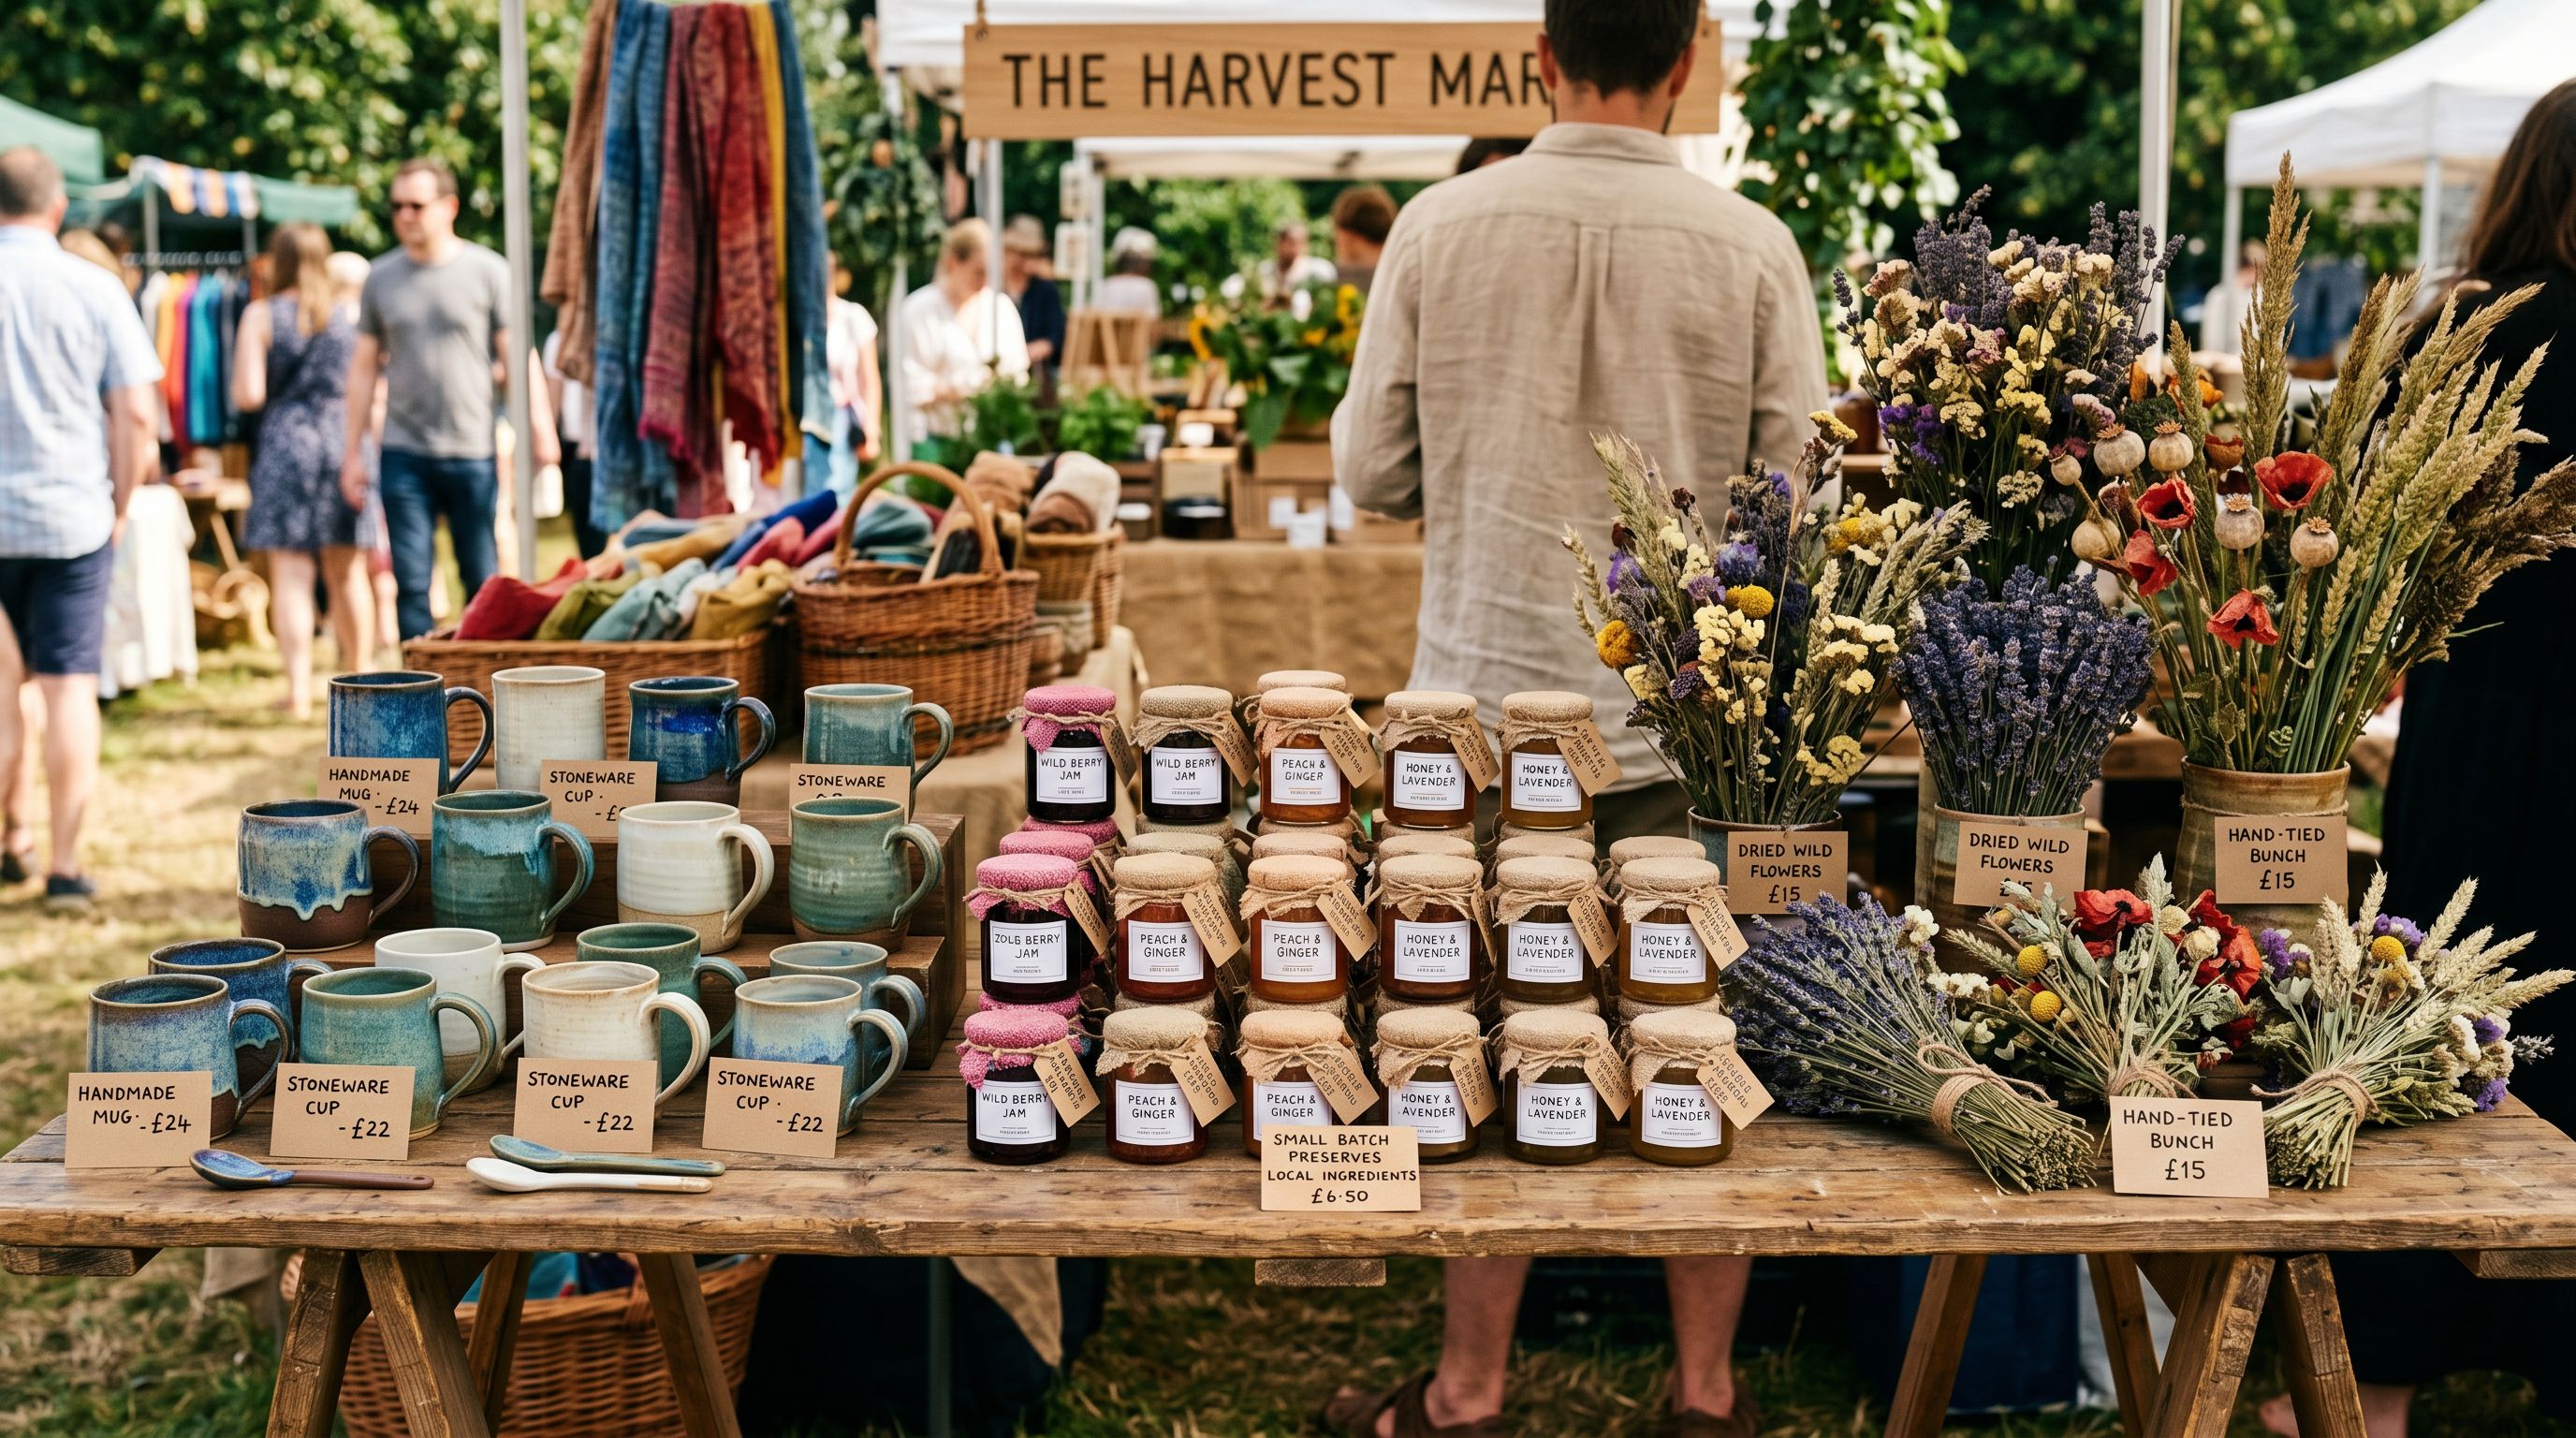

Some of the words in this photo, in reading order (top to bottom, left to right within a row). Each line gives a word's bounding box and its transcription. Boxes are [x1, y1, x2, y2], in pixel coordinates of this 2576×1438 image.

[1003, 52, 1107, 110] THE
[1144, 51, 1396, 108] HARVEST
[1041, 757, 1067, 769] WILD
[1071, 757, 1103, 768] BERRY
[1155, 758, 1181, 769] WILD
[1186, 758, 1217, 769] BERRY
[1282, 759, 1315, 769] PEACH
[1406, 763, 1442, 773] HONEY
[1446, 764, 1452, 773] &
[1523, 764, 1558, 774] HONEY
[1562, 766, 1569, 774] &
[329, 770, 410, 782] HANDMADE
[550, 771, 636, 785] STONEWARE
[798, 774, 886, 787] STONEWARE
[1060, 771, 1081, 780] JAM
[1175, 771, 1195, 780] JAM
[1285, 771, 1323, 781] GINGER
[1402, 775, 1456, 786] LAVENDER
[1518, 776, 1573, 787] LAVENDER
[1969, 833, 2019, 849] DRIED
[2027, 838, 2070, 854] WILD
[1738, 844, 1785, 858] DRIED
[1793, 844, 1832, 858] WILD
[2250, 848, 2305, 863] BUNCH
[1981, 855, 2053, 873] FLOWERS
[1750, 864, 1822, 878] FLOWERS
[2260, 870, 2295, 889] £15
[1768, 885, 1801, 904] £15
[1026, 934, 1060, 945] BERRY
[1140, 934, 1177, 944] PEACH
[1181, 934, 1188, 944] &
[1273, 933, 1310, 944] PEACH
[1315, 934, 1321, 944] &
[1407, 934, 1445, 945] HONEY
[1449, 934, 1456, 944] &
[1519, 934, 1558, 945] HONEY
[1563, 936, 1569, 945] &
[1642, 935, 1680, 946] HONEY
[1685, 936, 1691, 946] &
[1015, 948, 1039, 958] JAM
[1144, 947, 1186, 958] GINGER
[1277, 947, 1319, 958] GINGER
[1403, 947, 1460, 958] LAVENDER
[1517, 947, 1574, 959] LAVENDER
[1639, 947, 1696, 959] LAVENDER
[287, 1077, 389, 1093] STONEWARE
[528, 1072, 629, 1088] STONEWARE
[718, 1071, 815, 1091] STONEWARE
[79, 1086, 175, 1101] HANDMADE
[982, 1093, 1008, 1104] WILD
[1013, 1093, 1048, 1104] BERRY
[1267, 1093, 1304, 1104] PEACH
[1310, 1095, 1315, 1104] &
[1401, 1093, 1440, 1104] HONEY
[551, 1095, 584, 1108] CUP
[1129, 1095, 1164, 1106] PEACH
[1170, 1096, 1177, 1105] &
[1531, 1095, 1570, 1107] HONEY
[1575, 1097, 1582, 1106] &
[1655, 1095, 1693, 1107] HONEY
[1699, 1097, 1705, 1107] &
[306, 1101, 340, 1115] CUP
[1003, 1108, 1026, 1118] JAM
[1132, 1108, 1175, 1119] GINGER
[1271, 1108, 1314, 1117] GINGER
[1528, 1108, 1586, 1120] LAVENDER
[1651, 1108, 1710, 1121] LAVENDER
[2124, 1109, 2232, 1127] HAND-TIED
[1274, 1134, 1326, 1146] SMALL
[1338, 1134, 1389, 1146] BATCH
[2151, 1134, 2214, 1149] BUNCH
[1289, 1152, 1382, 1163] PRESERVES
[2165, 1159, 2205, 1180] £15
[1268, 1170, 1313, 1181] LOCAL
[1323, 1170, 1416, 1181] INGREDIENTS
